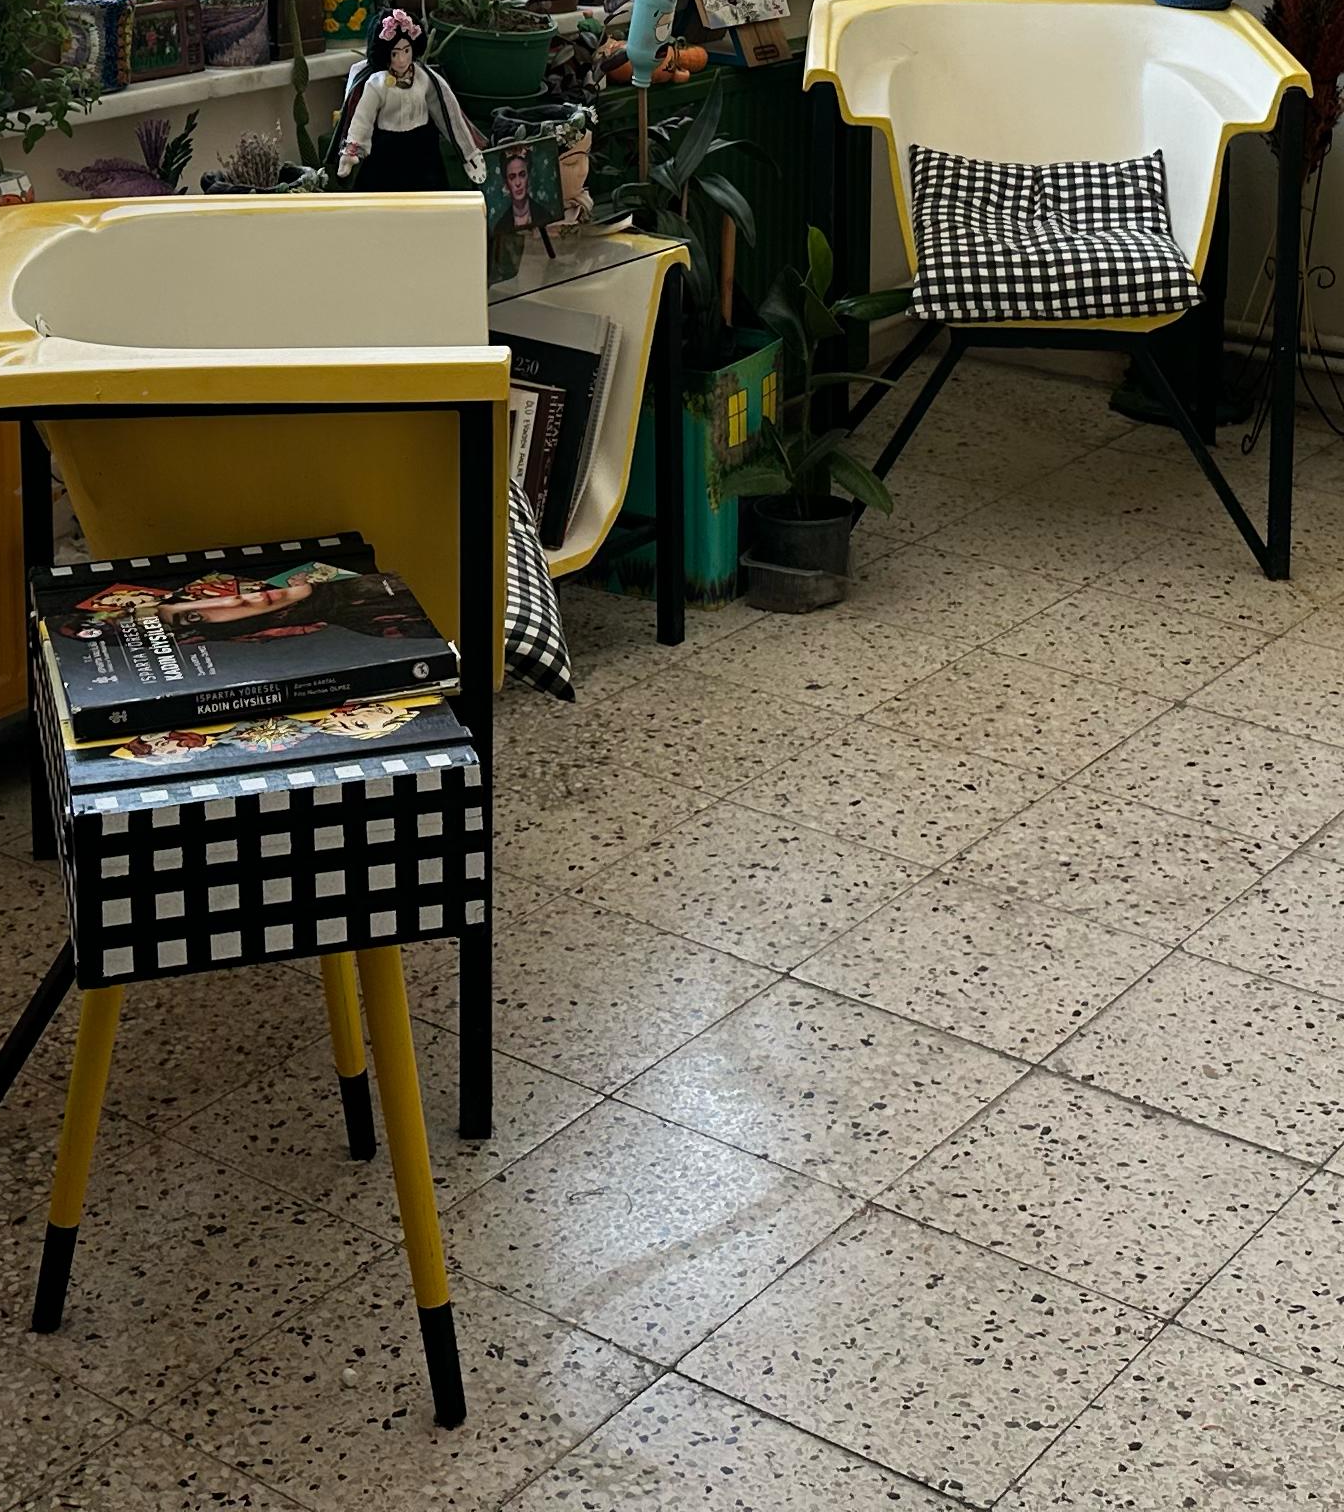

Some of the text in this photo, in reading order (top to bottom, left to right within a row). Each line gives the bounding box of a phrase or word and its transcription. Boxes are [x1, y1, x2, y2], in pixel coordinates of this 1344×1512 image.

[513, 356, 540, 377] 250
[132, 652, 158, 685] ISPARTA
[157, 654, 184, 682] KADIN
[195, 690, 236, 704] ISPARTA
[197, 701, 231, 715] KADIN
